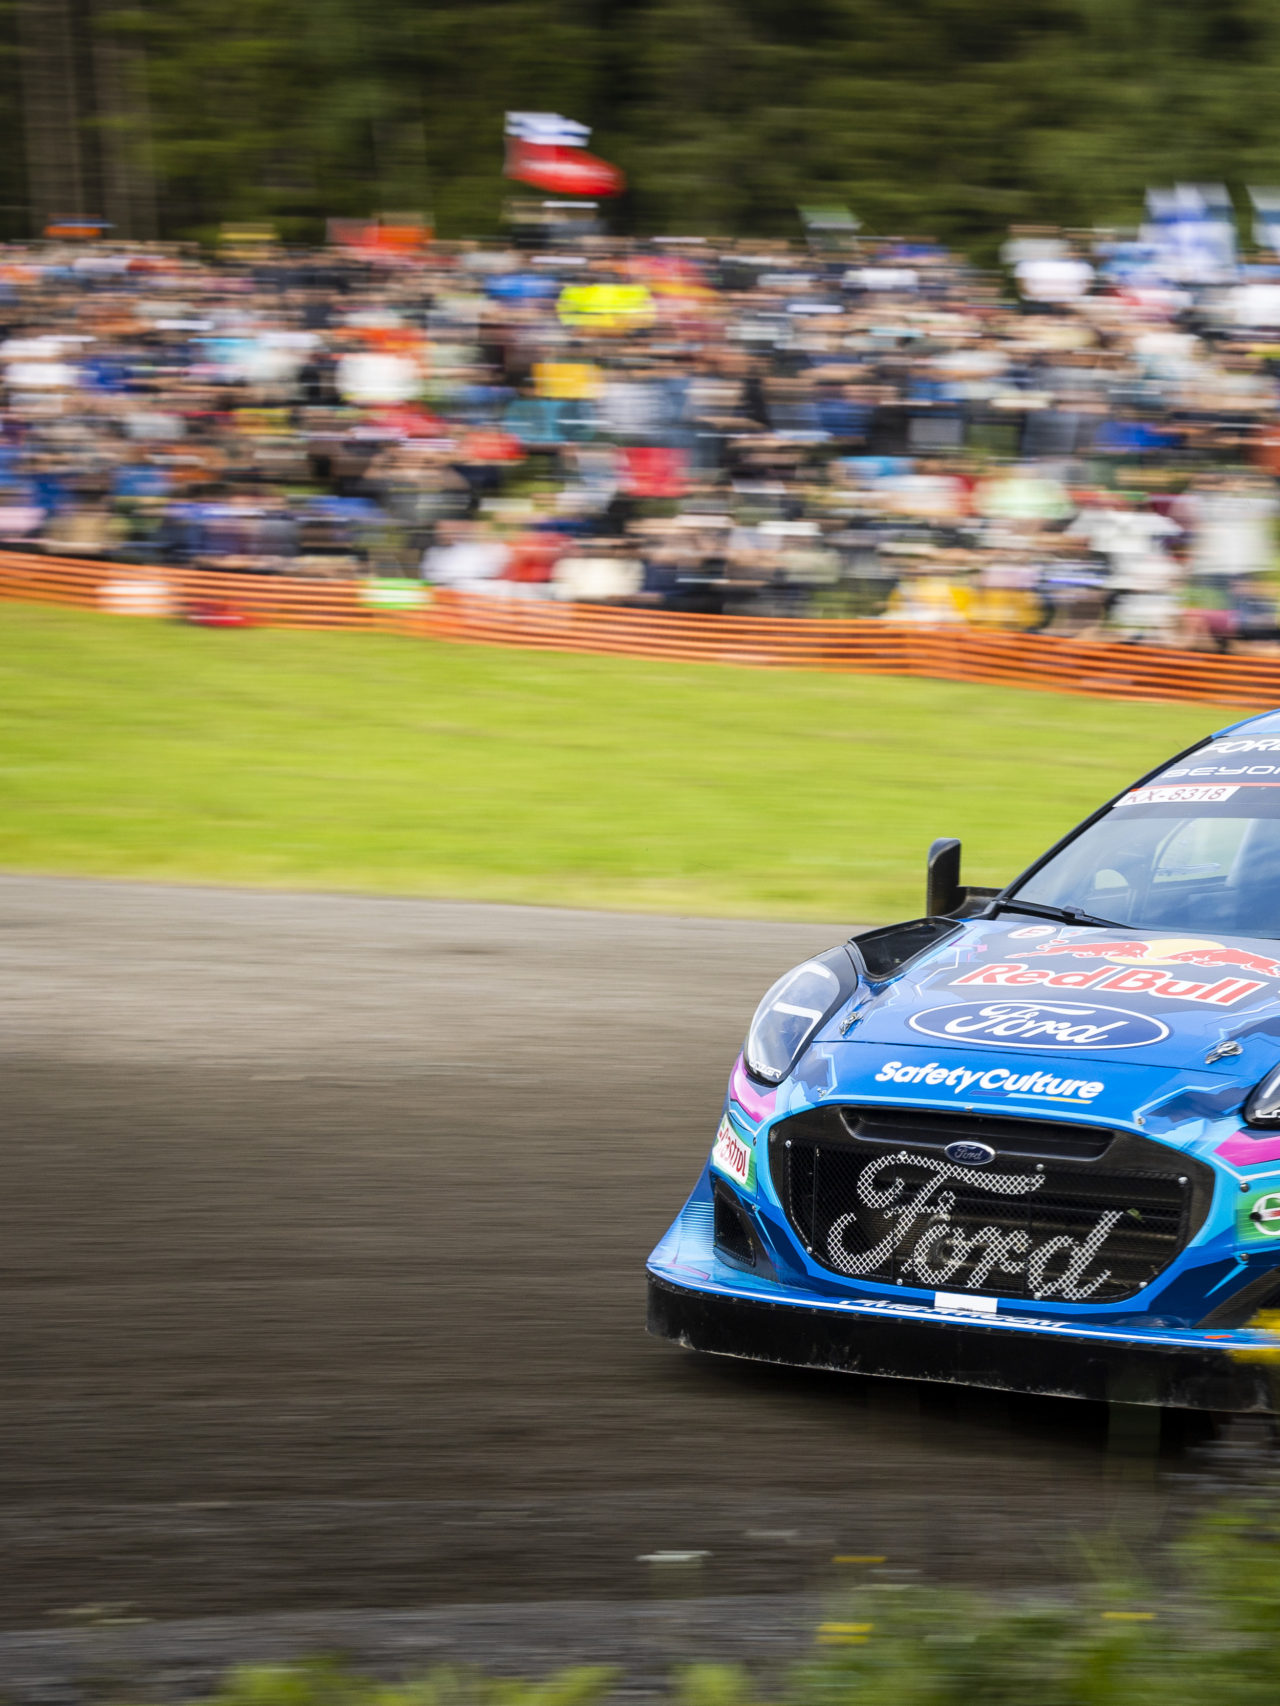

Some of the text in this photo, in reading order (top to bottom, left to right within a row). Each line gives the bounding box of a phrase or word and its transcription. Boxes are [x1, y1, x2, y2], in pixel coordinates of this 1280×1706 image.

[944, 1003, 1131, 1044] Ford
[874, 1061, 1105, 1099] SafetyCulture
[954, 1144, 984, 1161] Ford
[827, 1153, 1126, 1301] Ford
